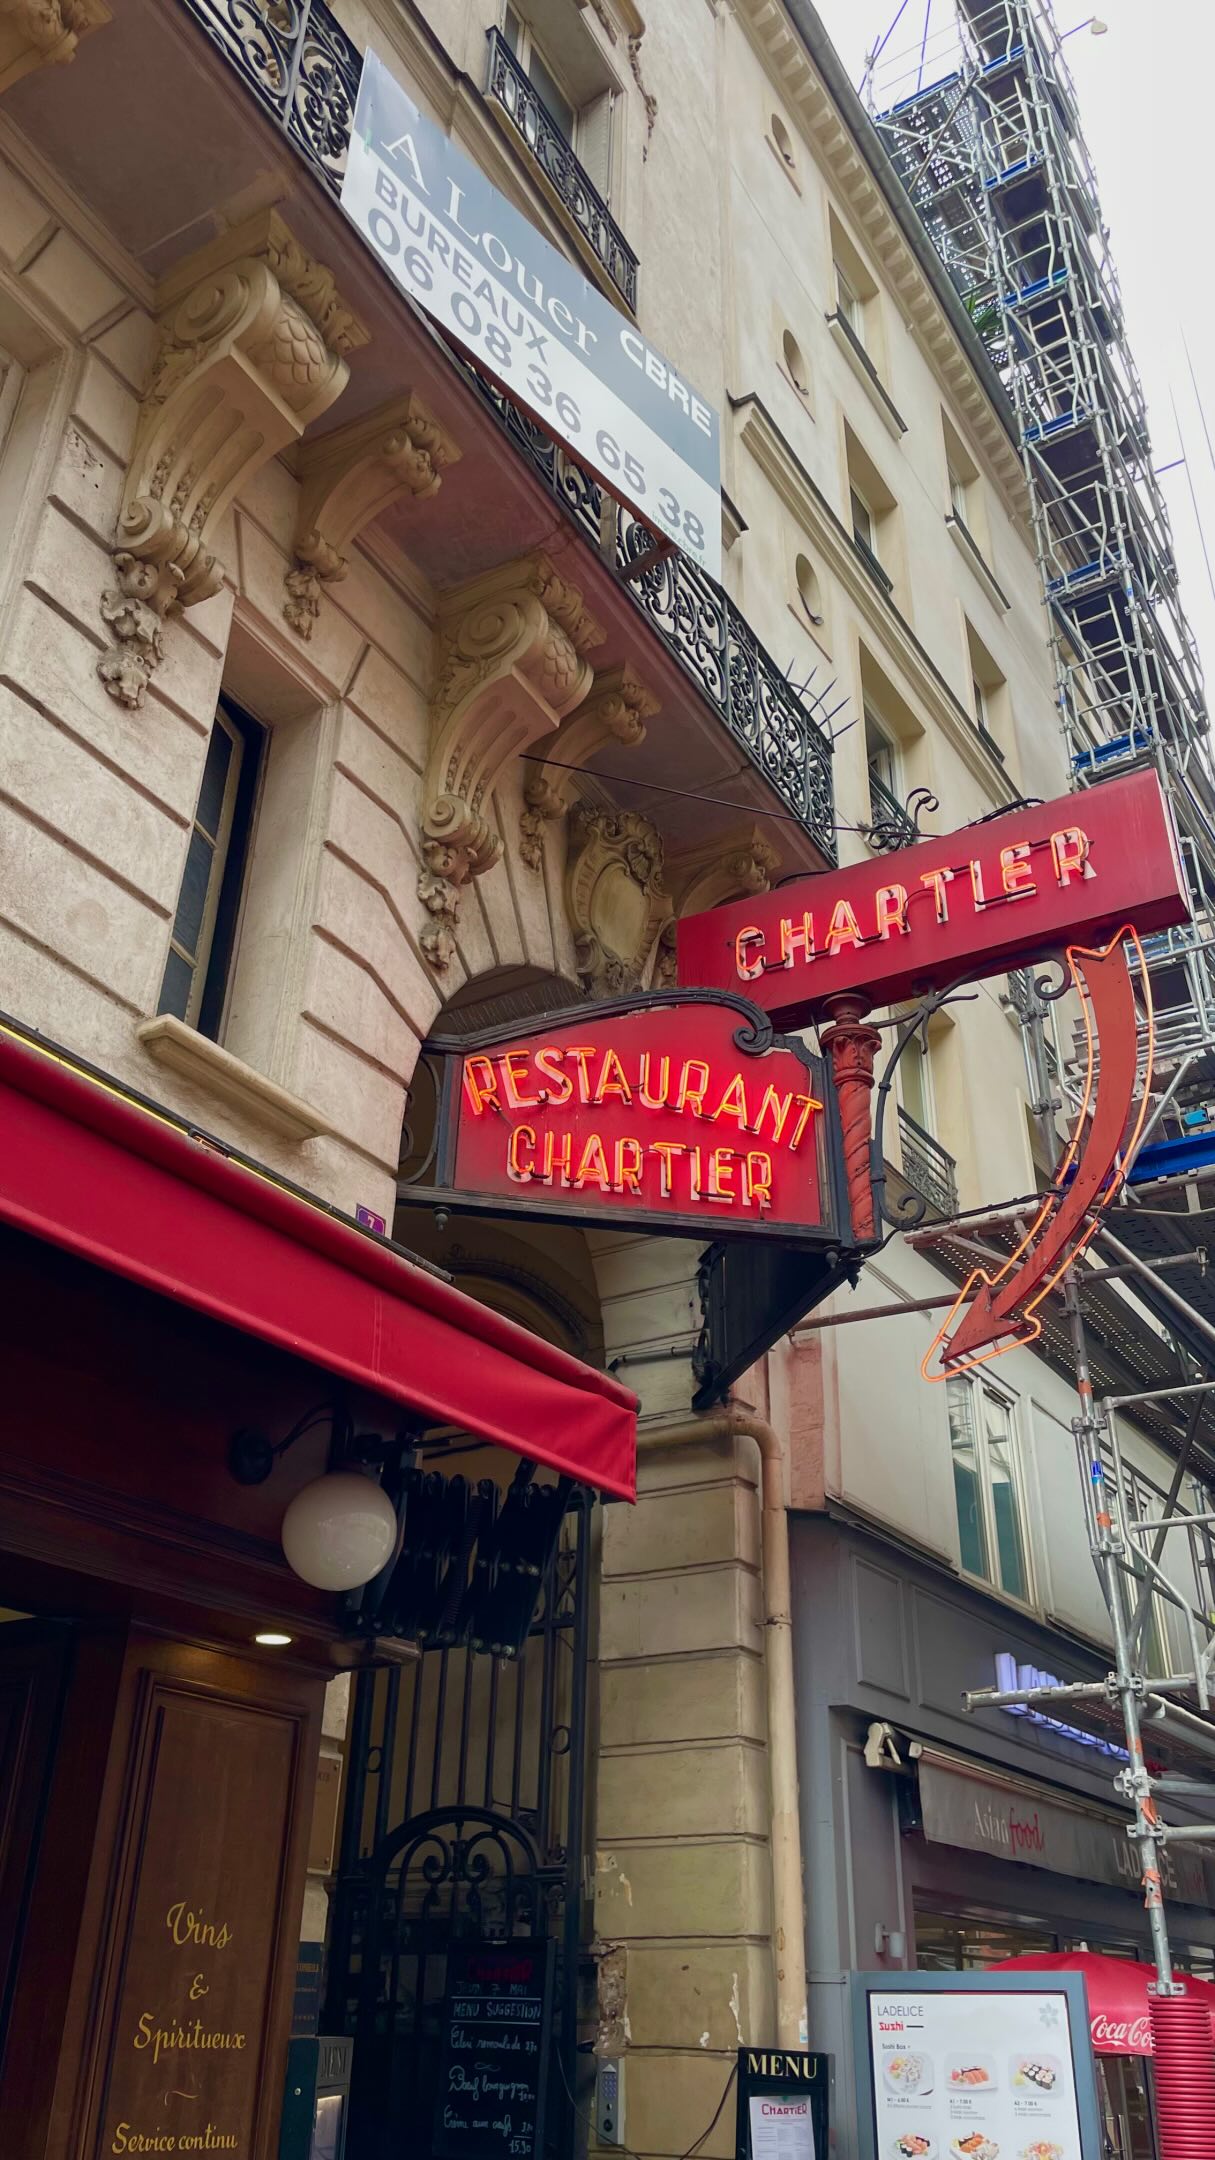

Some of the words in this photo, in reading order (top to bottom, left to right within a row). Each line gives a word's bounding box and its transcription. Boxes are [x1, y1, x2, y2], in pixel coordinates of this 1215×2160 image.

[375, 168, 552, 364] BUREAUX
[381, 133, 431, 196] A
[443, 177, 599, 357] Louer
[367, 207, 434, 292] 06
[451, 292, 513, 369] 08
[526, 363, 582, 434] 36
[595, 429, 647, 496] 65
[658, 488, 705, 551] 38
[619, 328, 713, 438] CBRE
[734, 826, 1097, 982] CHARTIER
[462, 1045, 824, 1151] RESTAURANT
[506, 1124, 773, 1207] CHARTIER
[974, 1800, 1009, 1844] Asian
[1112, 1838, 1178, 1889] LADCE
[166, 1901, 233, 1949] Vins
[189, 1973, 210, 2000] &
[453, 2002, 480, 2018] MENU
[877, 2005, 924, 2017] LADELICE
[133, 2012, 246, 2064] Spiritueux
[1091, 2014, 1156, 2048] Coca-Co
[748, 2053, 818, 2079] MENU
[111, 2122, 175, 2154] Service
[178, 2122, 238, 2150] continu
